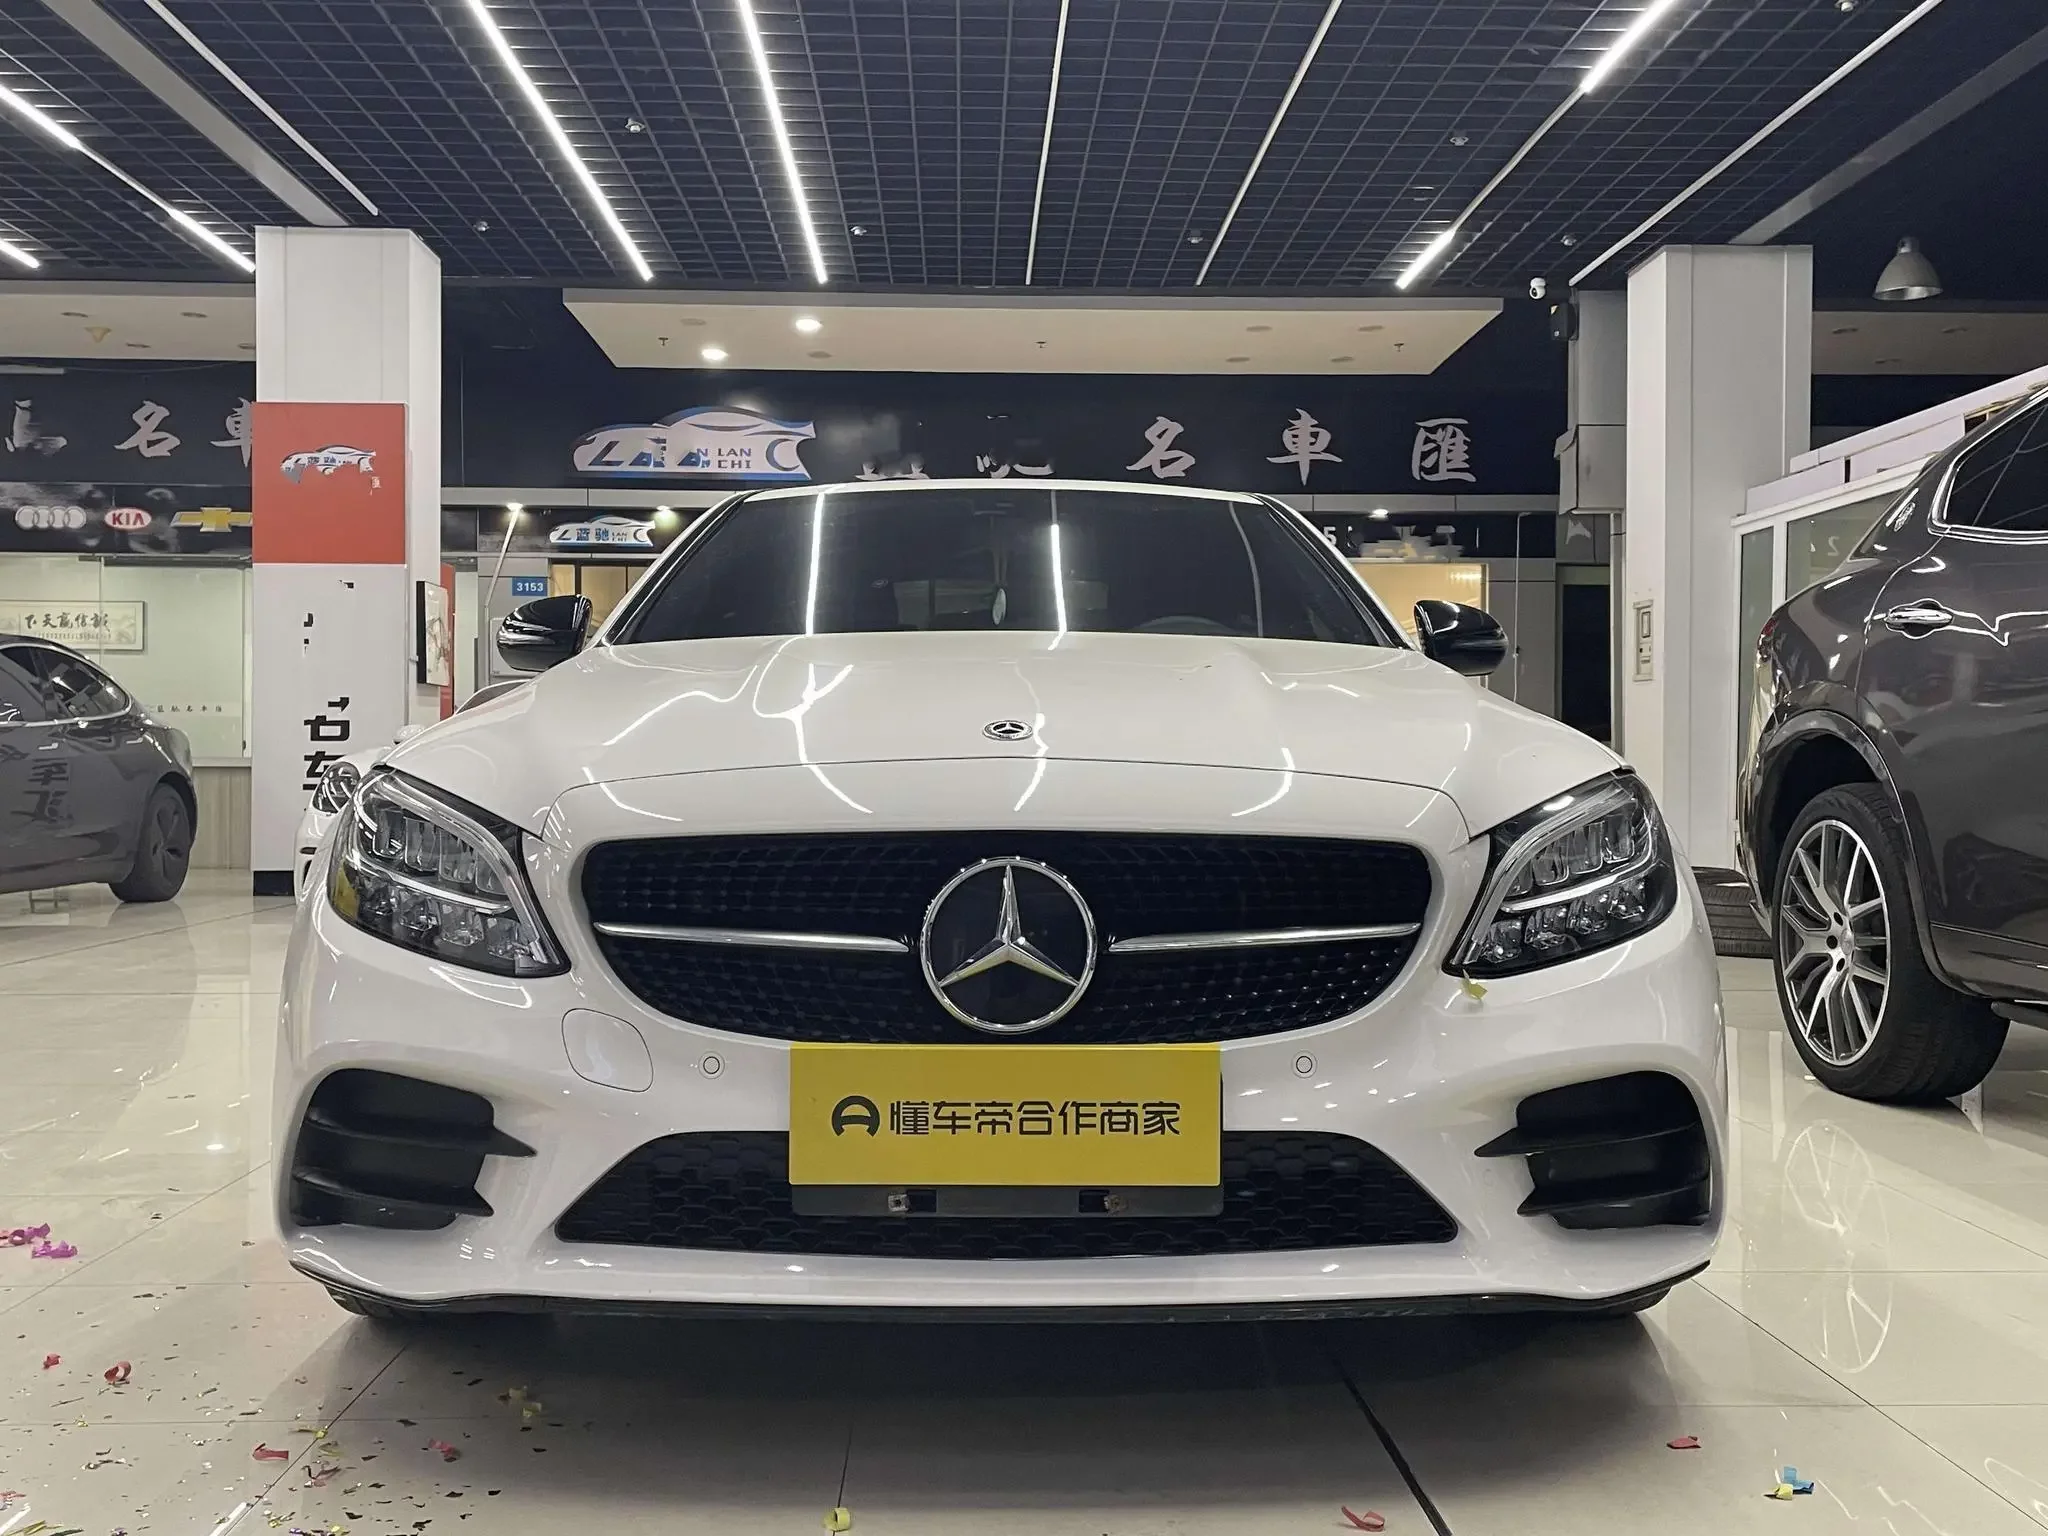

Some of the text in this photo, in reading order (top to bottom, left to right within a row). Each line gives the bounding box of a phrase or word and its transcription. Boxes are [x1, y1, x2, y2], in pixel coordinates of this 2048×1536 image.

[111, 512, 146, 526] KIA
[516, 582, 544, 591] 3153
[889, 1100, 1181, 1136] 懂车帝合作商家
